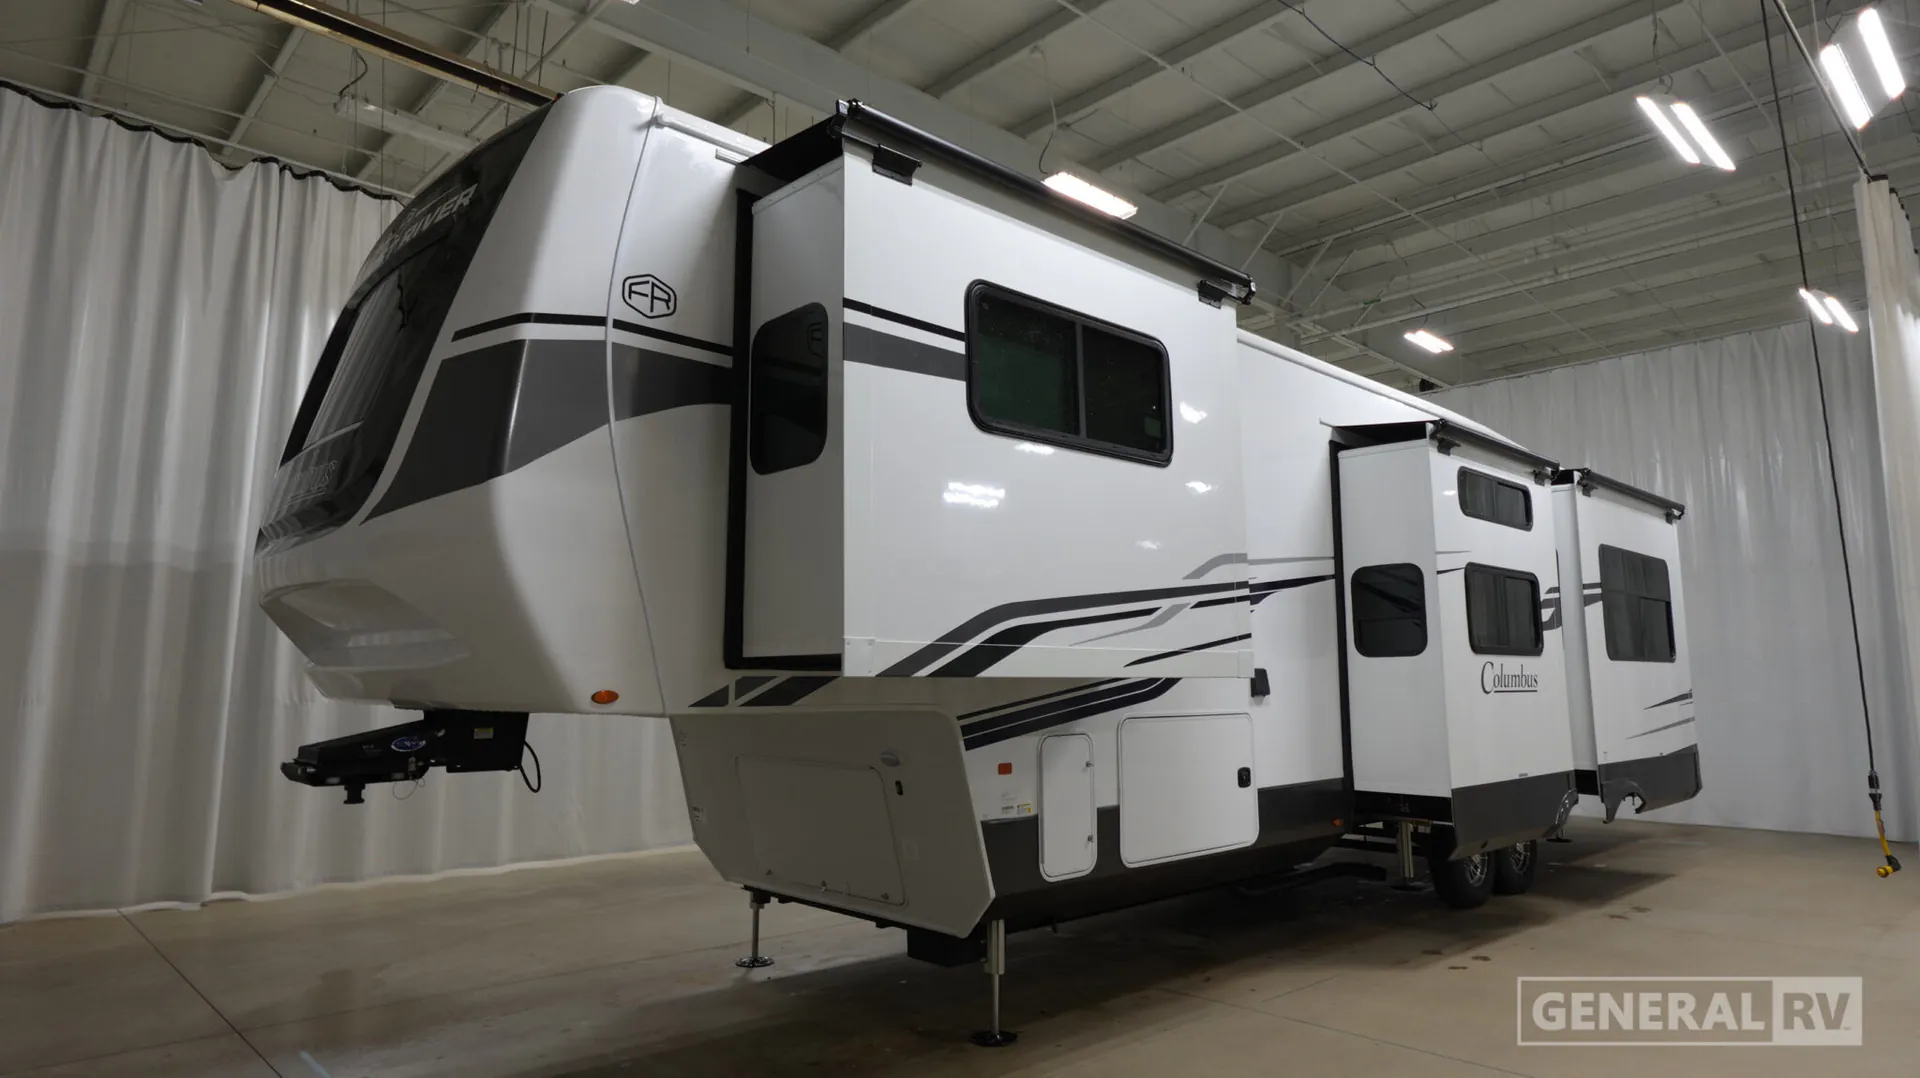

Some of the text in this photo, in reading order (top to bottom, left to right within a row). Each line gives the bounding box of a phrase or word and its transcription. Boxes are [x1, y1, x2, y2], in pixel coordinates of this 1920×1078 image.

[402, 183, 478, 243] RIVER
[628, 280, 671, 313] FR
[1481, 661, 1538, 695] Columbus
